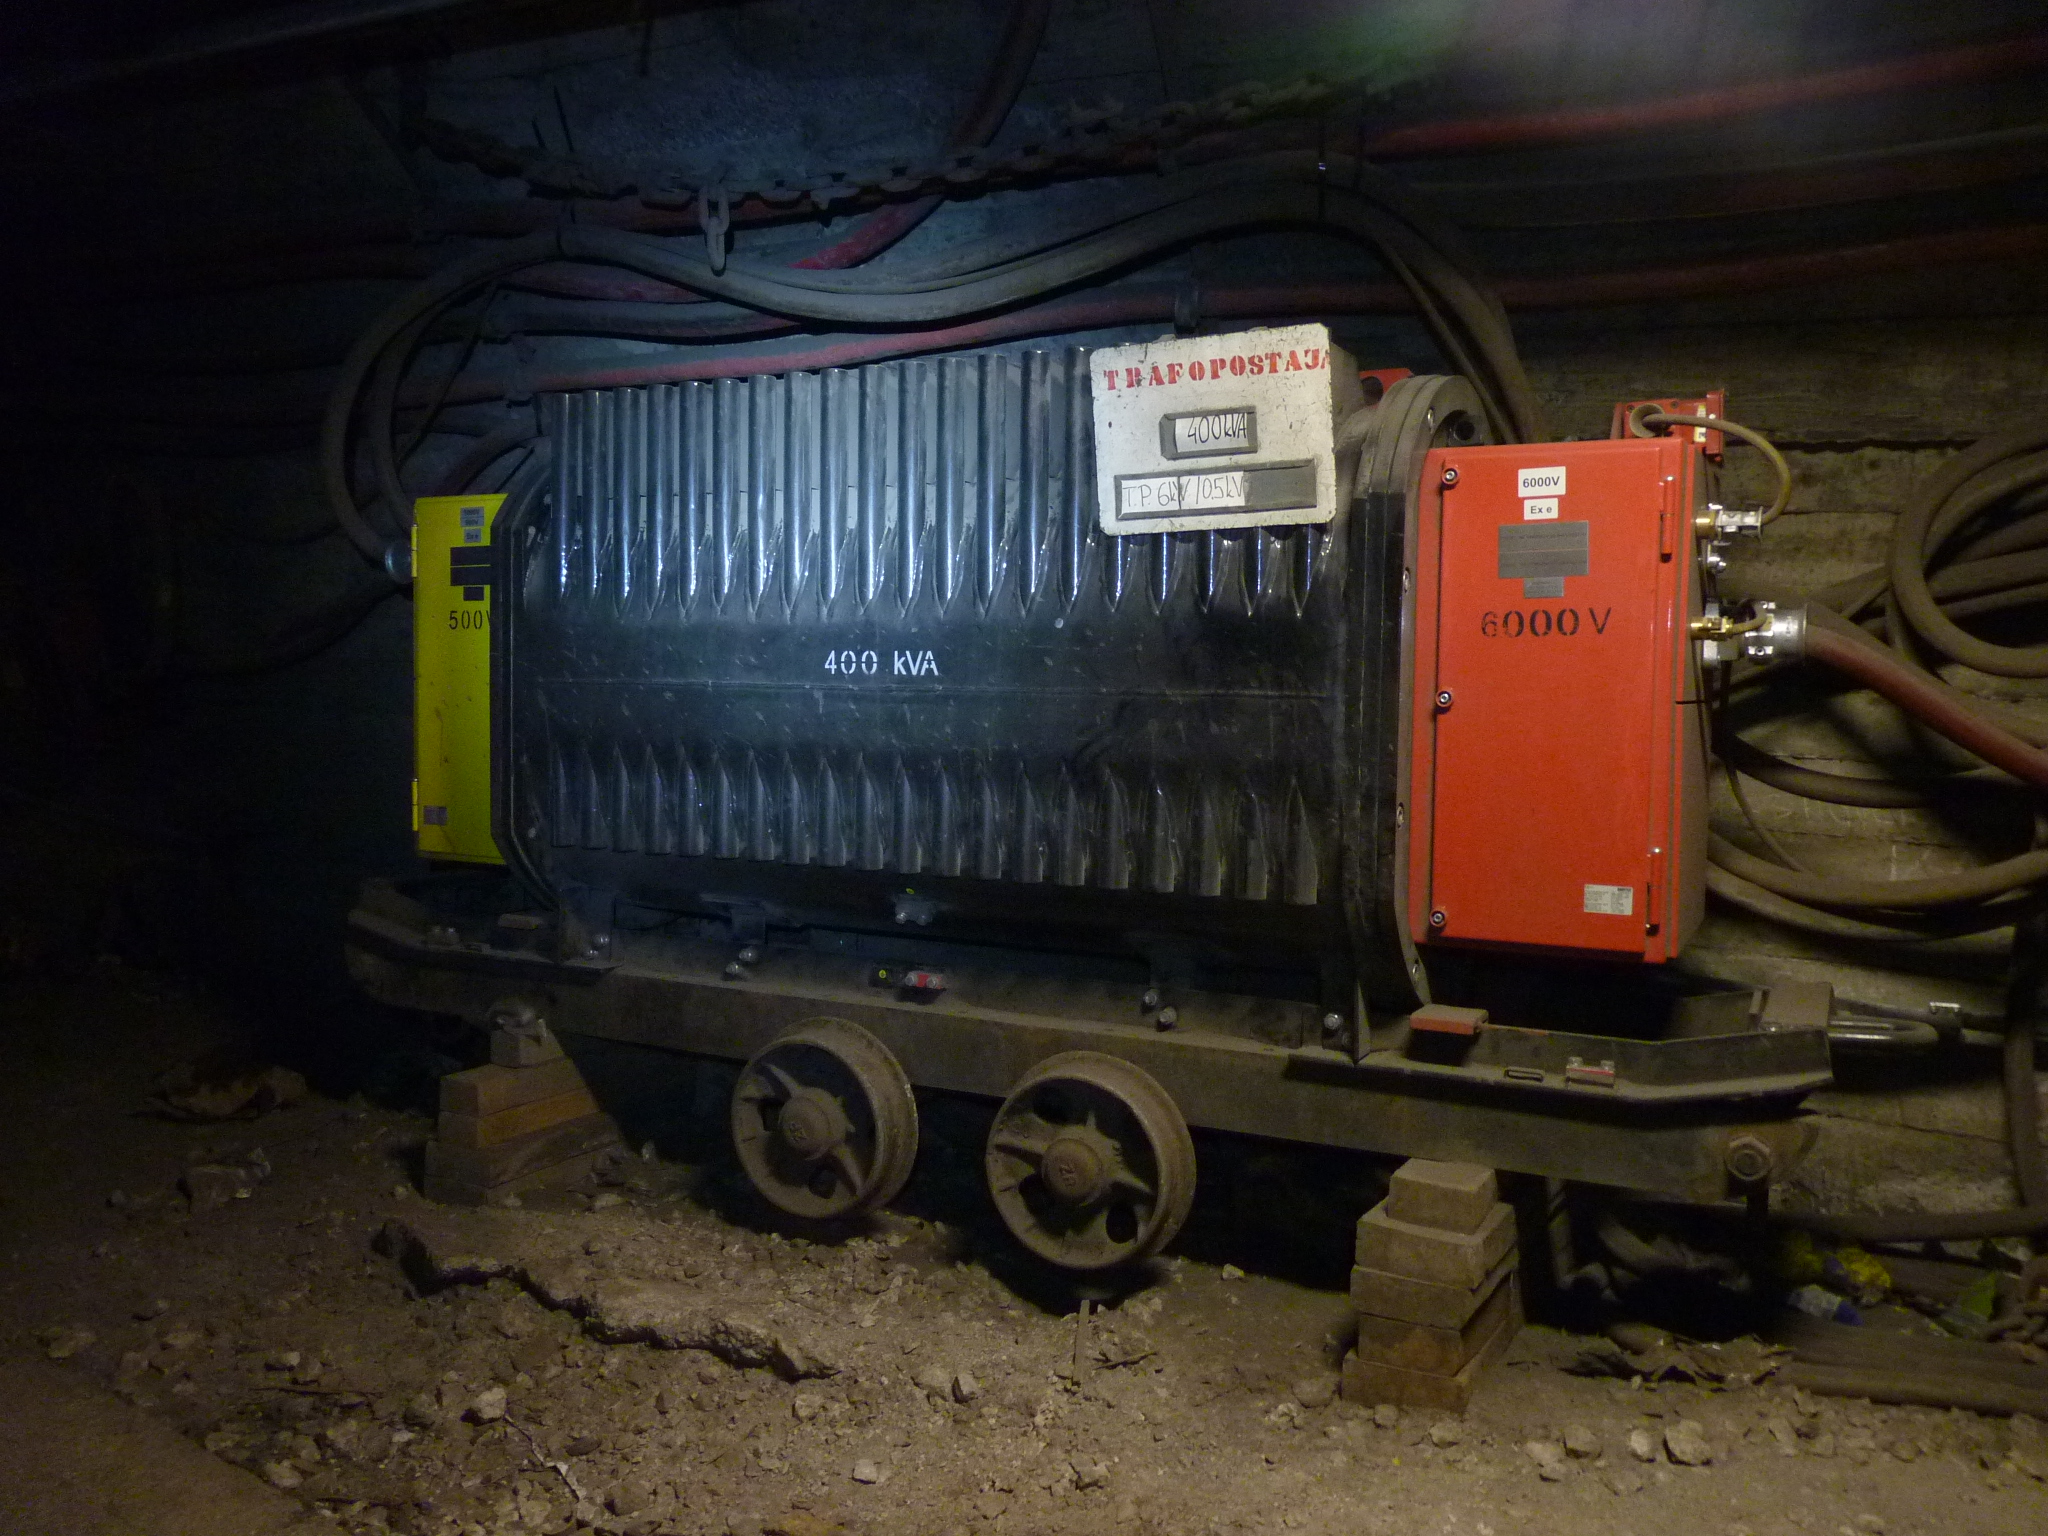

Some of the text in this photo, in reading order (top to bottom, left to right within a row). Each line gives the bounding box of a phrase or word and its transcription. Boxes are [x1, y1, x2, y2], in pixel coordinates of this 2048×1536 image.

[1522, 475, 1561, 488] 6000V
[1530, 505, 1553, 515] Ex e
[824, 650, 939, 676] 400 kVA
